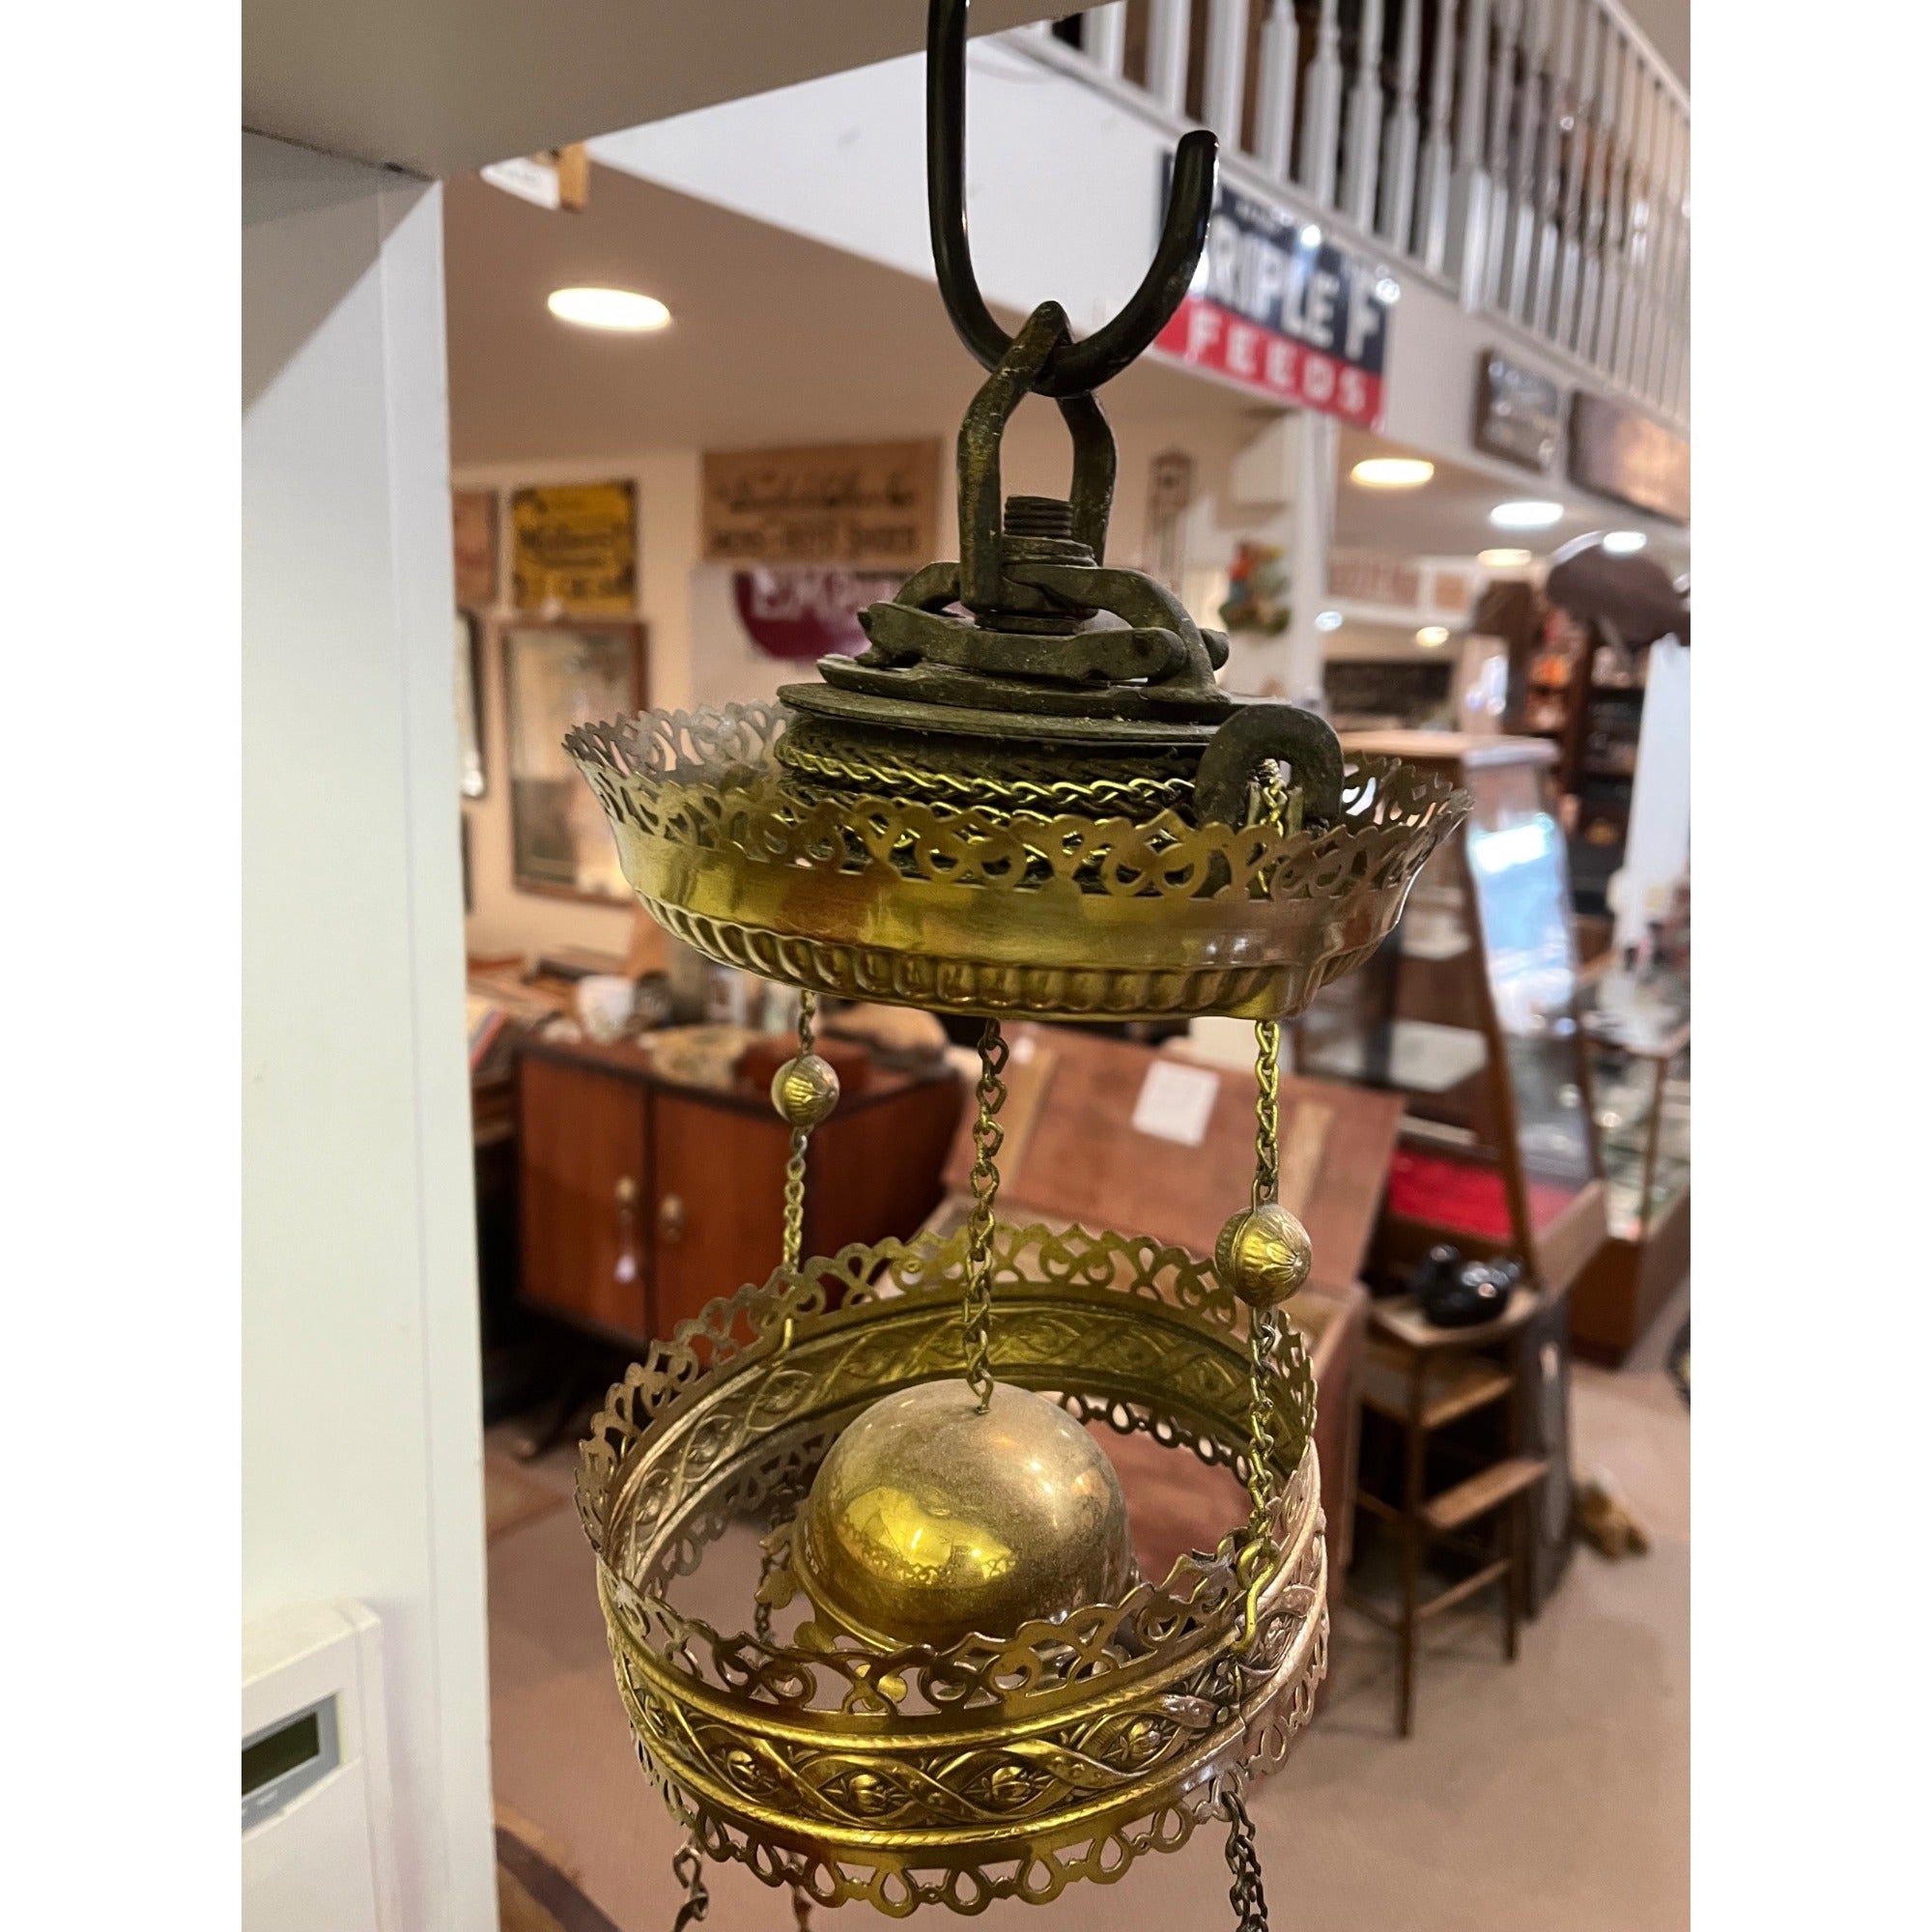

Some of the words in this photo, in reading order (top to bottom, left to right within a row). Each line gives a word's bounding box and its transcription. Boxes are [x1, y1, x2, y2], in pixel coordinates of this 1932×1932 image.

[1208, 213, 1341, 348] RIPLE
[1343, 255, 1383, 359] F
[1186, 302, 1367, 412] FEEDS
